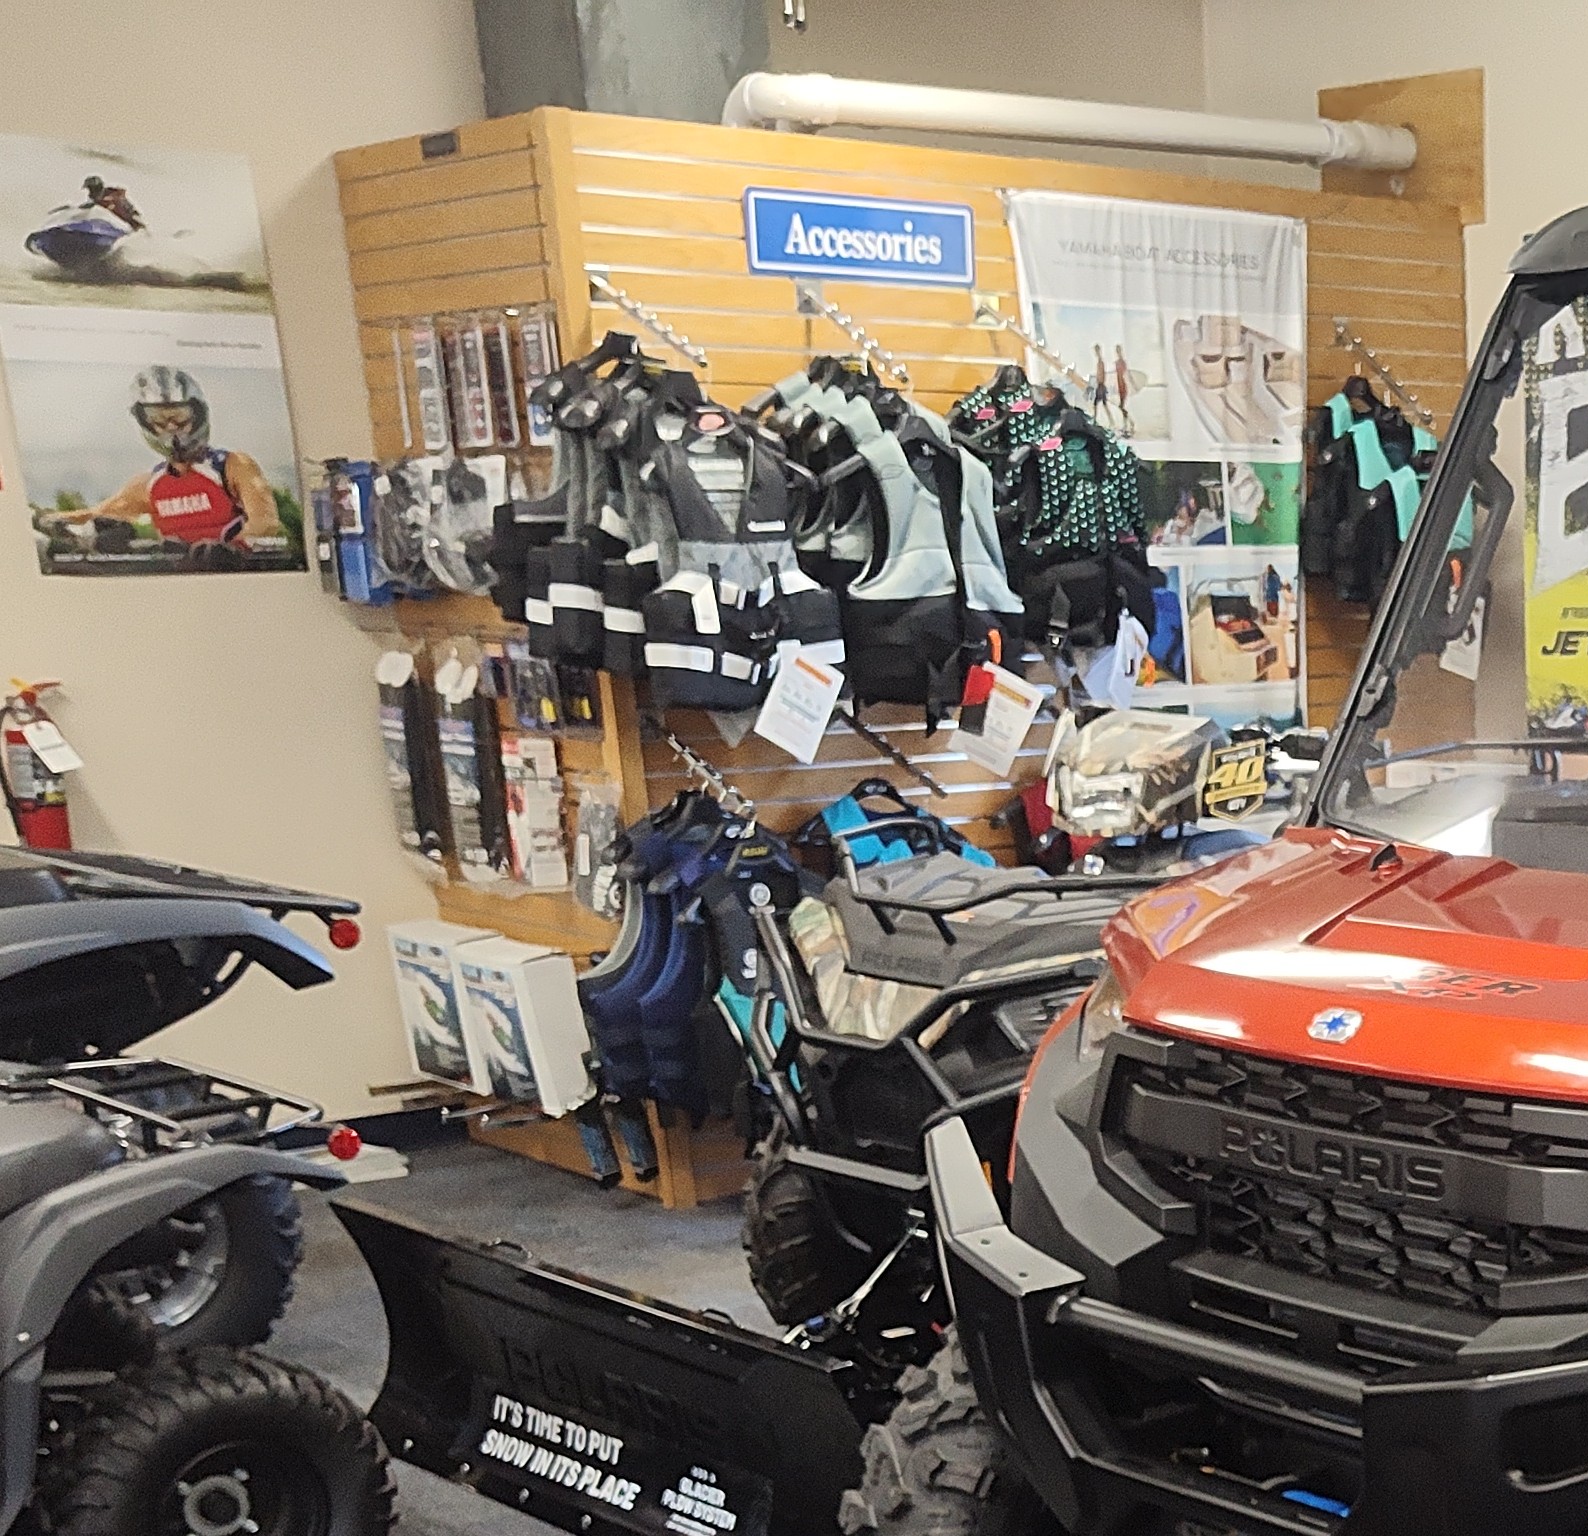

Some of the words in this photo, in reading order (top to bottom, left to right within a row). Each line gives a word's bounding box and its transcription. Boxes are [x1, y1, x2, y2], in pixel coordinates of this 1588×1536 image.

[784, 212, 943, 266] Accessories
[1217, 1120, 1445, 1200] POLARIS
[493, 1394, 524, 1428] IT'S
[526, 1405, 564, 1444] TIME
[565, 1420, 587, 1453] TO
[586, 1429, 624, 1466] PUT
[480, 1428, 536, 1469] SNOW
[528, 1446, 555, 1477] IN
[549, 1454, 582, 1488] ITS
[574, 1465, 642, 1511] PLACE
